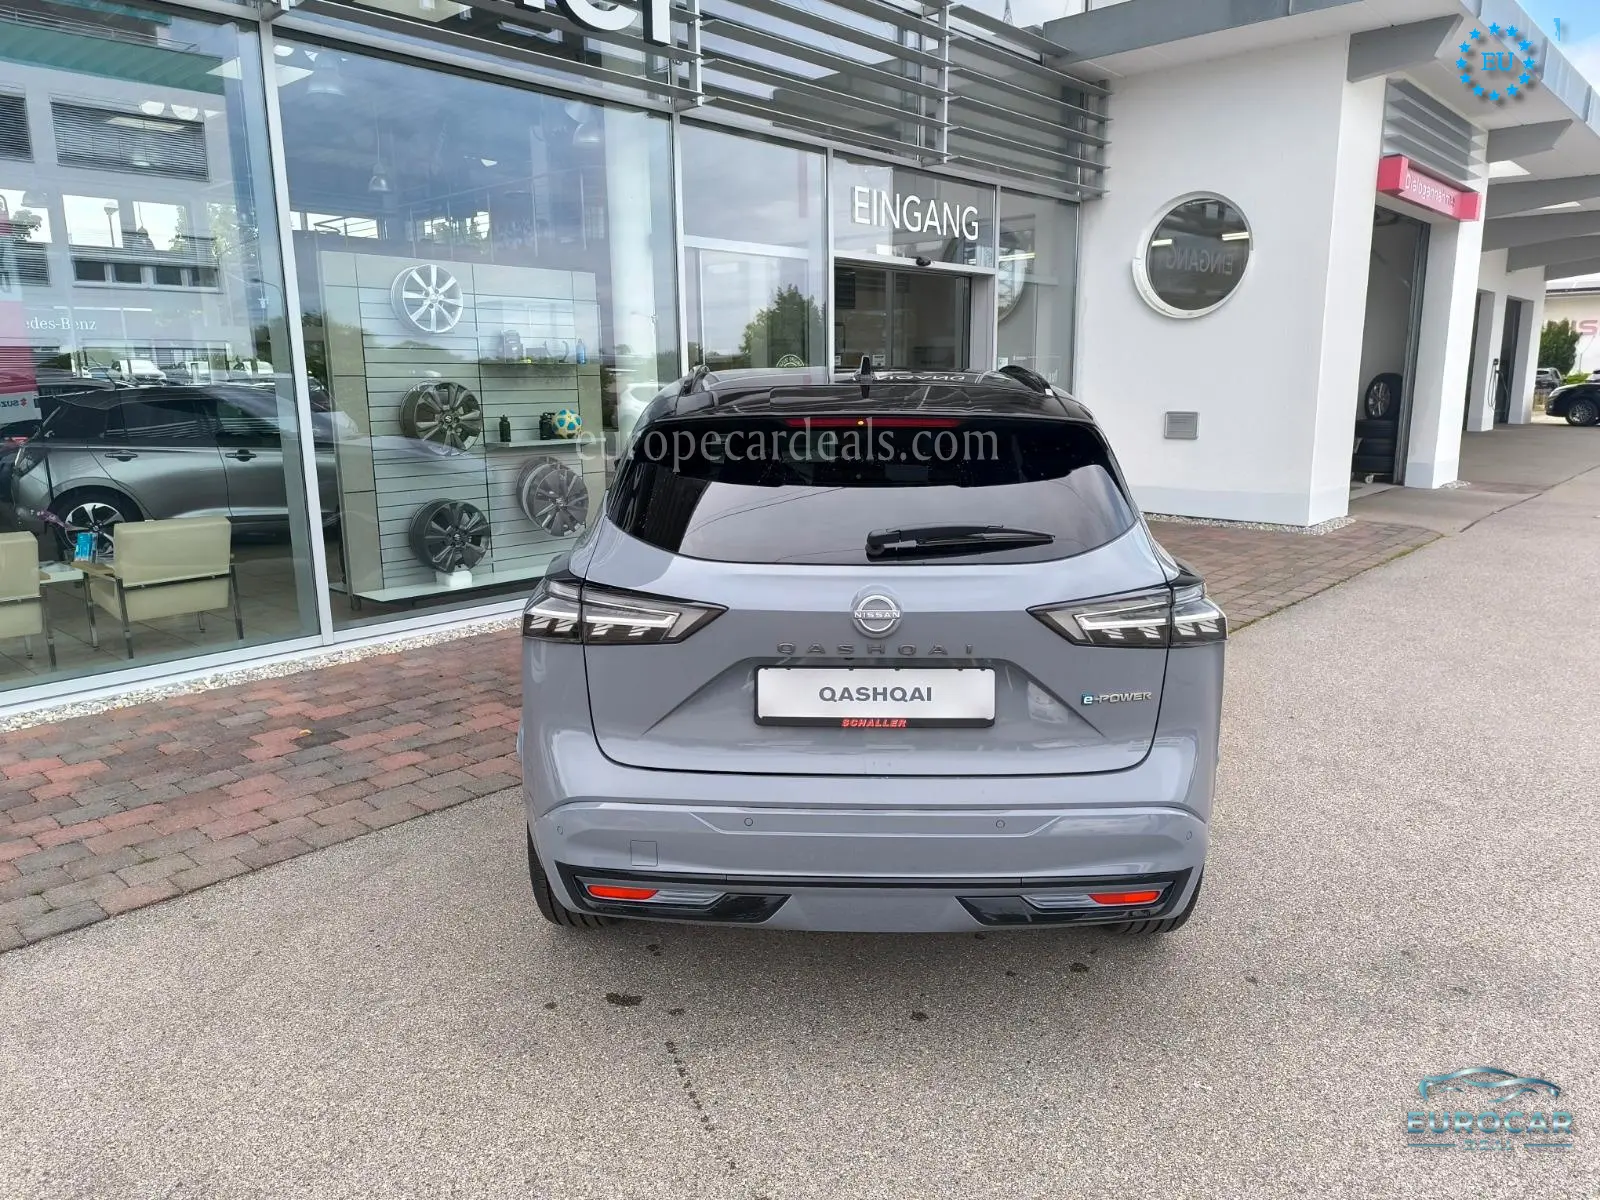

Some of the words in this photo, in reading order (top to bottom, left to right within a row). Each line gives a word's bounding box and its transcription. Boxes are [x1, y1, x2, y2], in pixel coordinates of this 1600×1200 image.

[853, 185, 979, 241] EINGANG
[777, 643, 974, 656] QASHQAI
[818, 686, 933, 703] QASHQAI
[1081, 691, 1152, 705] e-POWER
[841, 717, 908, 729] SCHALLER
